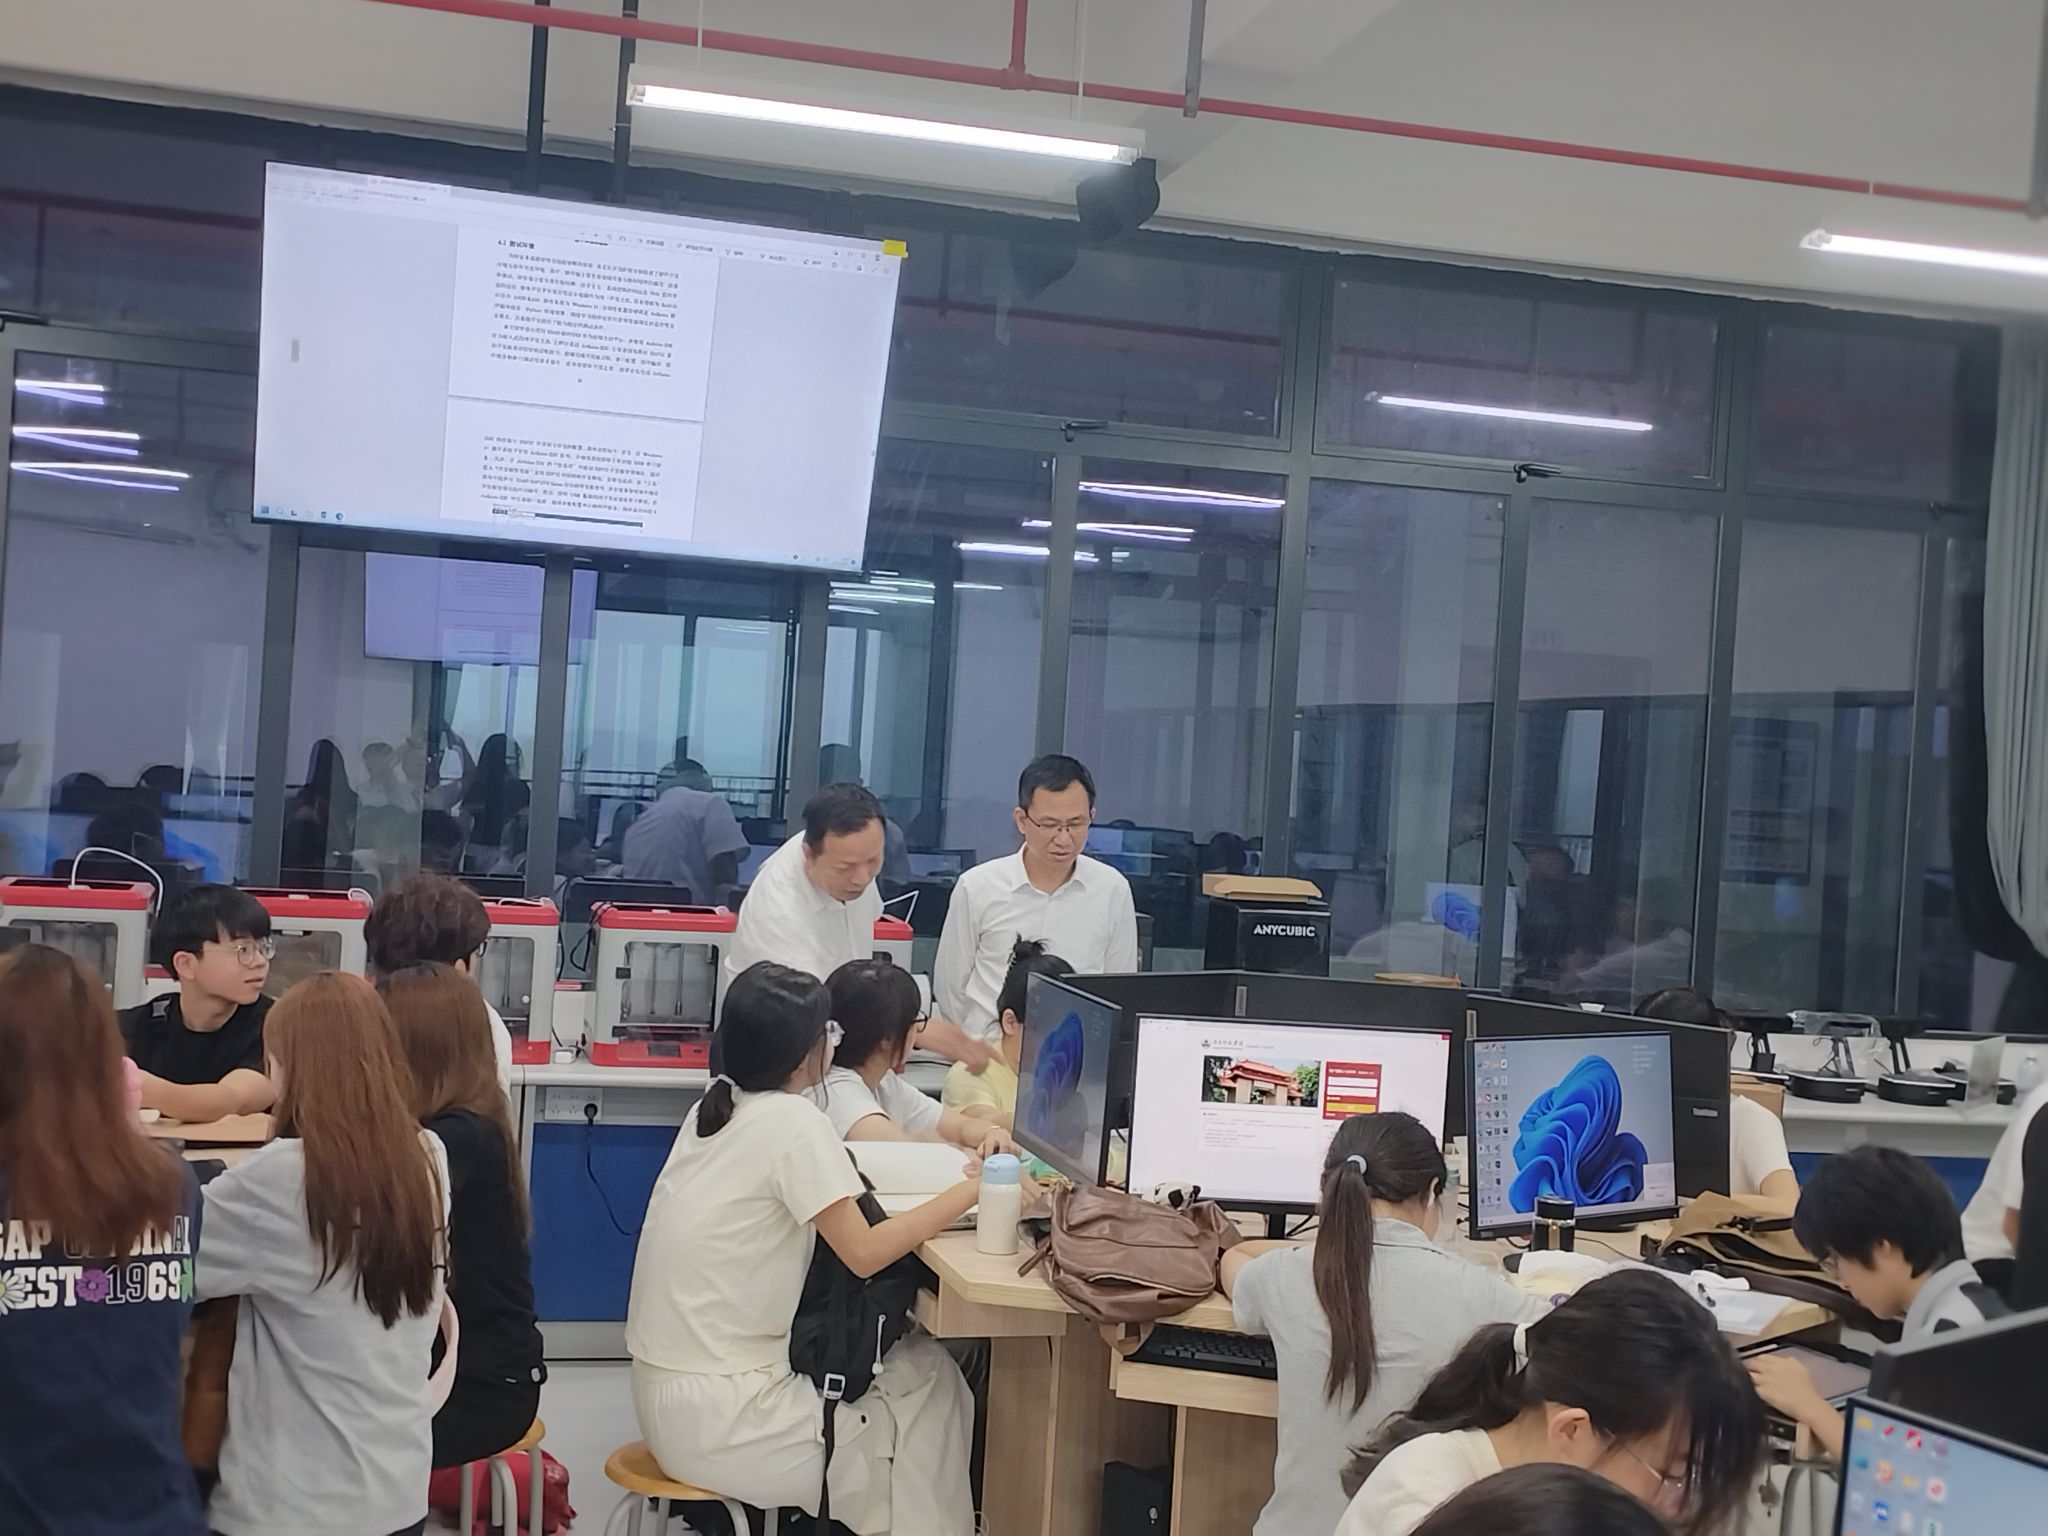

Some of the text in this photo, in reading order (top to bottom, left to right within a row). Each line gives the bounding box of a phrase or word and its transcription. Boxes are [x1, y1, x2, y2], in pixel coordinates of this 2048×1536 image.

[1253, 924, 1316, 937] ANYCUBIC
[0, 1219, 52, 1261] AP
[13, 1260, 182, 1309] EST 1969
